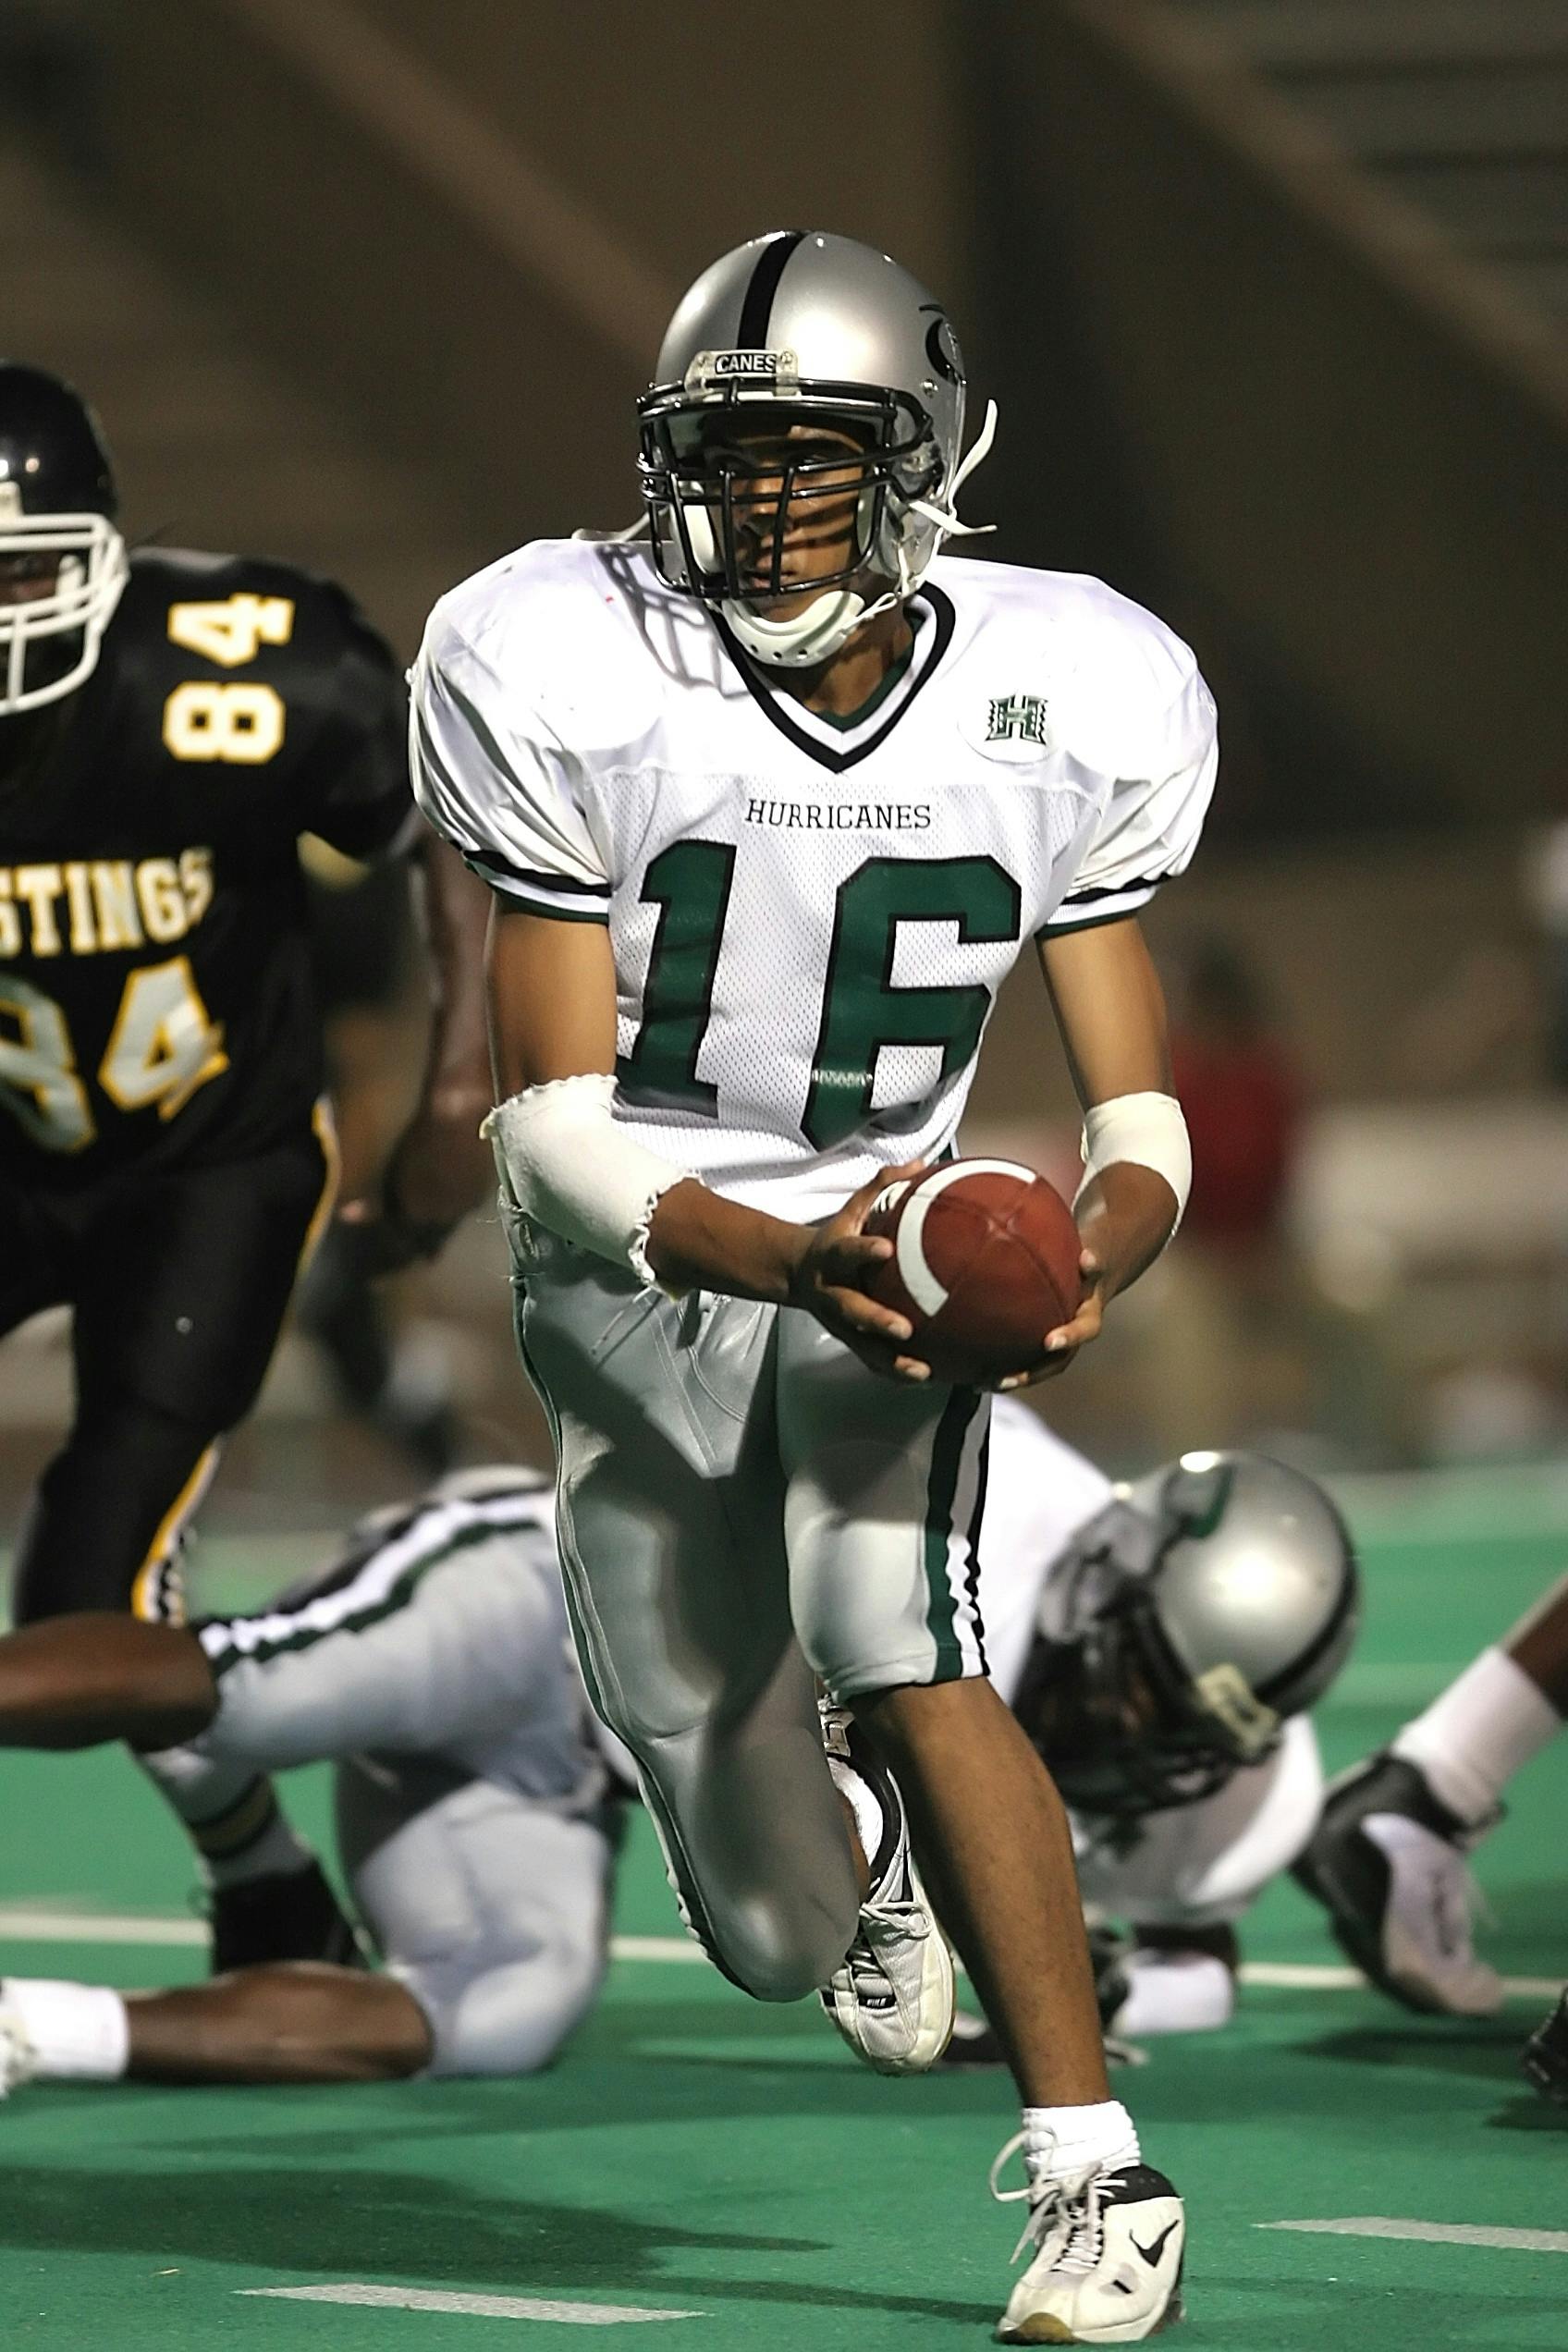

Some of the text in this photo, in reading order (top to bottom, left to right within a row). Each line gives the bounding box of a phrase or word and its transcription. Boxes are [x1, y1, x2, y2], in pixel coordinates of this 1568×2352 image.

[716, 354, 777, 374] CANES
[162, 592, 296, 765] 84
[744, 798, 932, 830] HURRICANES
[0, 956, 229, 1154] 84
[615, 839, 1022, 1156] 16
